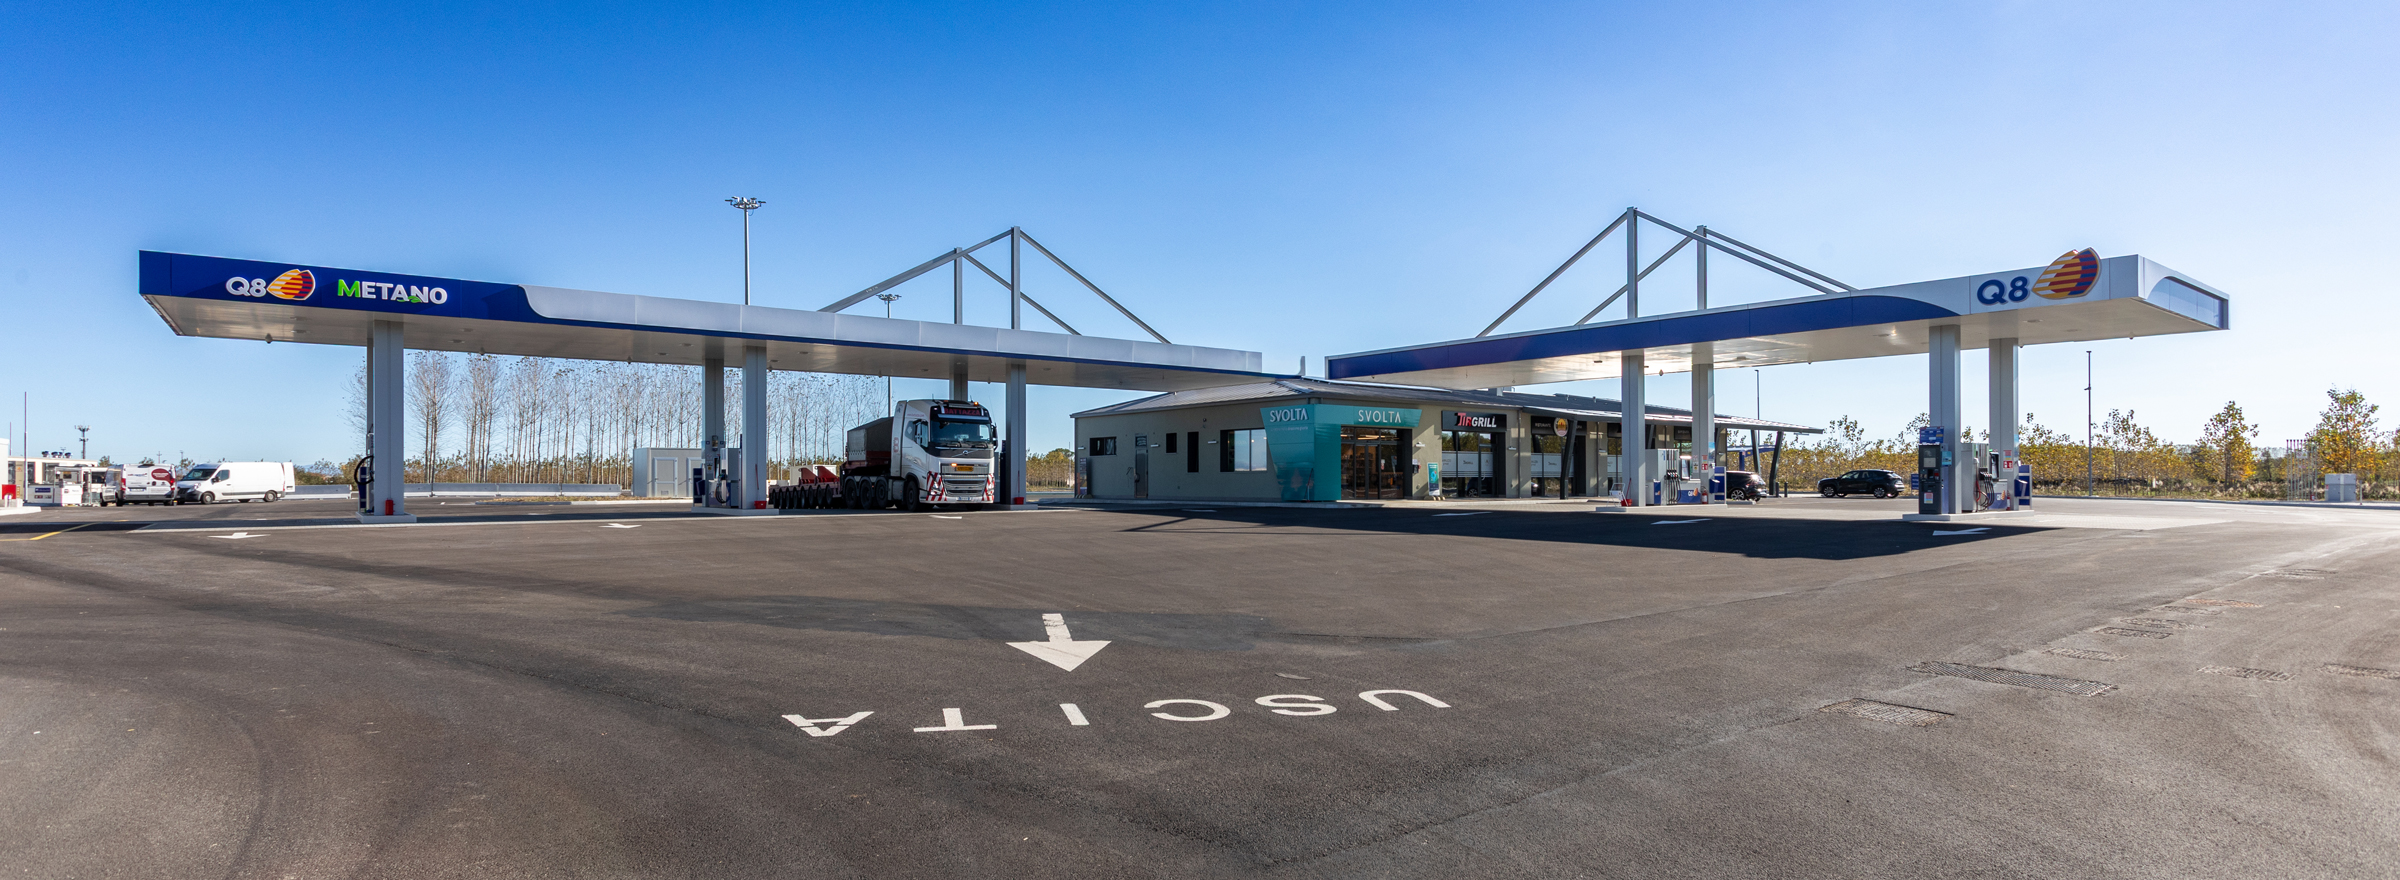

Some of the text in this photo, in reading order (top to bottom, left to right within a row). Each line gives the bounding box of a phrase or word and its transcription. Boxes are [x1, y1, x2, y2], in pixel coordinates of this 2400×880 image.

[225, 277, 448, 304] Q8 METANO
[1977, 276, 2029, 305] Q8
[944, 408, 980, 416] BATTAZZA
[1269, 408, 1308, 422] SVOLTA
[1358, 410, 1401, 423] SVOLTA
[781, 689, 1450, 738] USCITA
